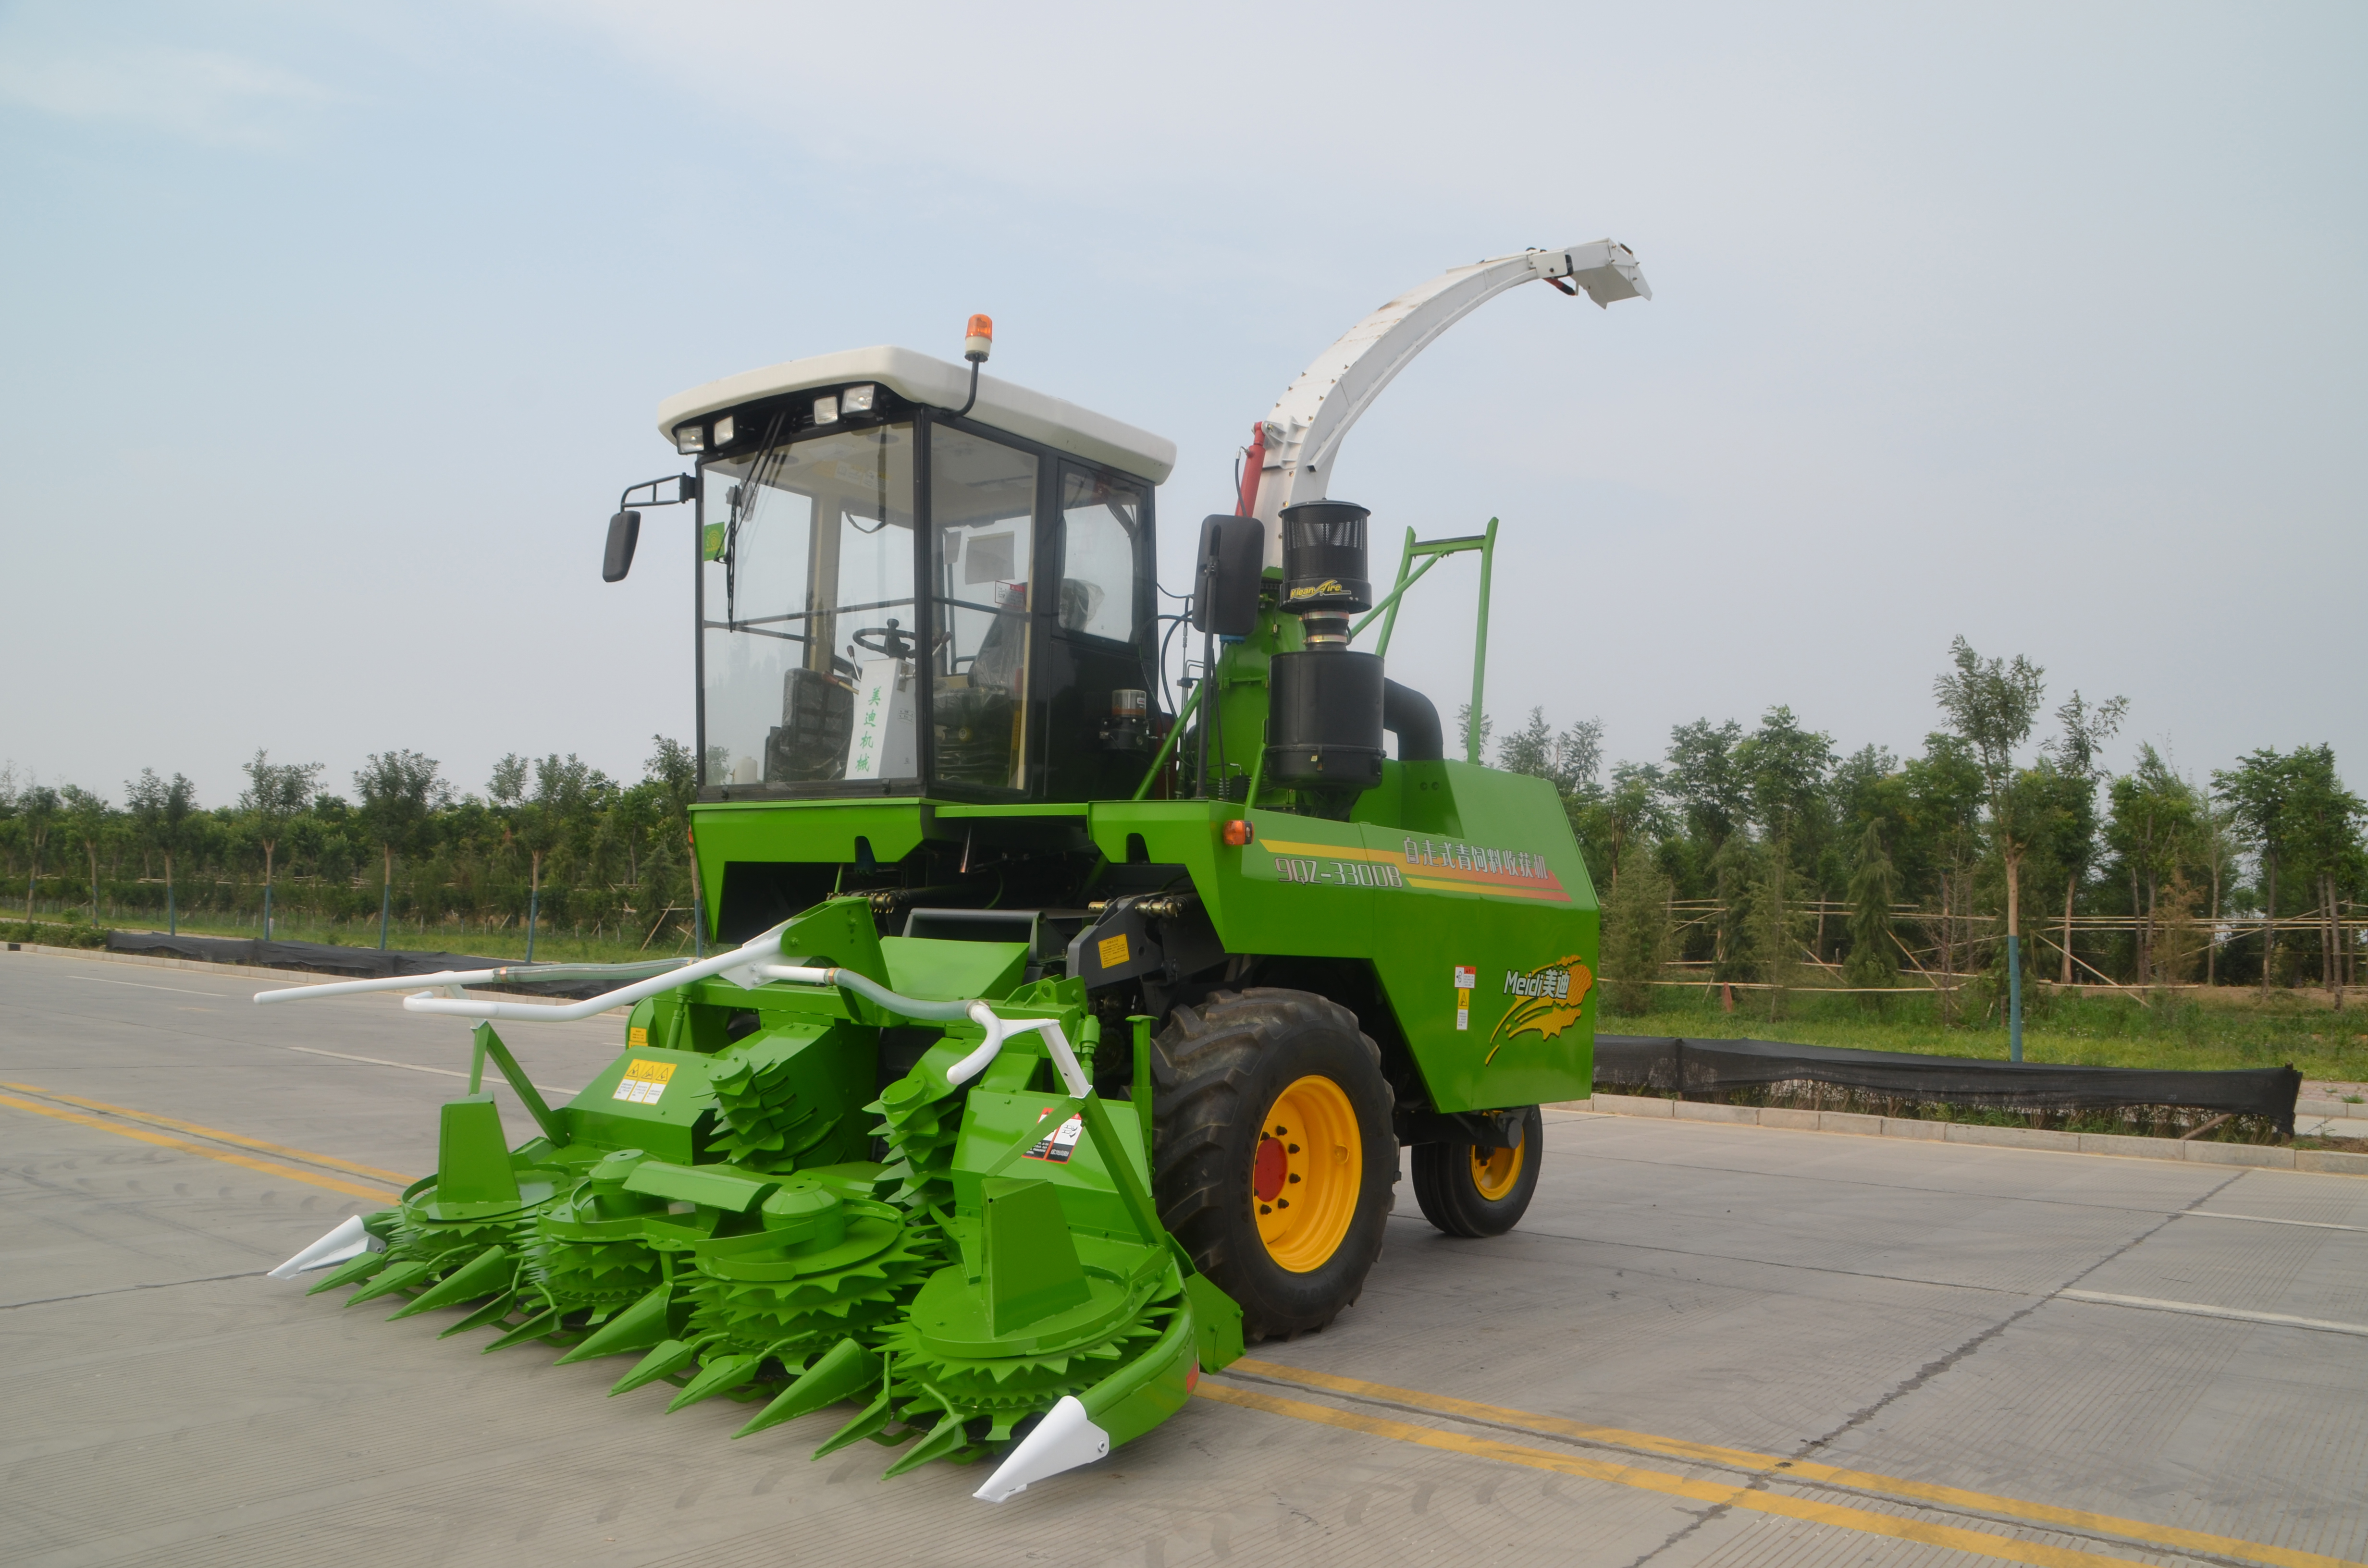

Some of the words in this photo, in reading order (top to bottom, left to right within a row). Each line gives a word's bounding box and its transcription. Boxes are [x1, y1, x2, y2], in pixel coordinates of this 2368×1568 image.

[855, 686, 882, 772] 美迪机械
[1274, 857, 1403, 889] 9QZ-3300B
[1403, 836, 1549, 880] 自走式青饲料收获机
